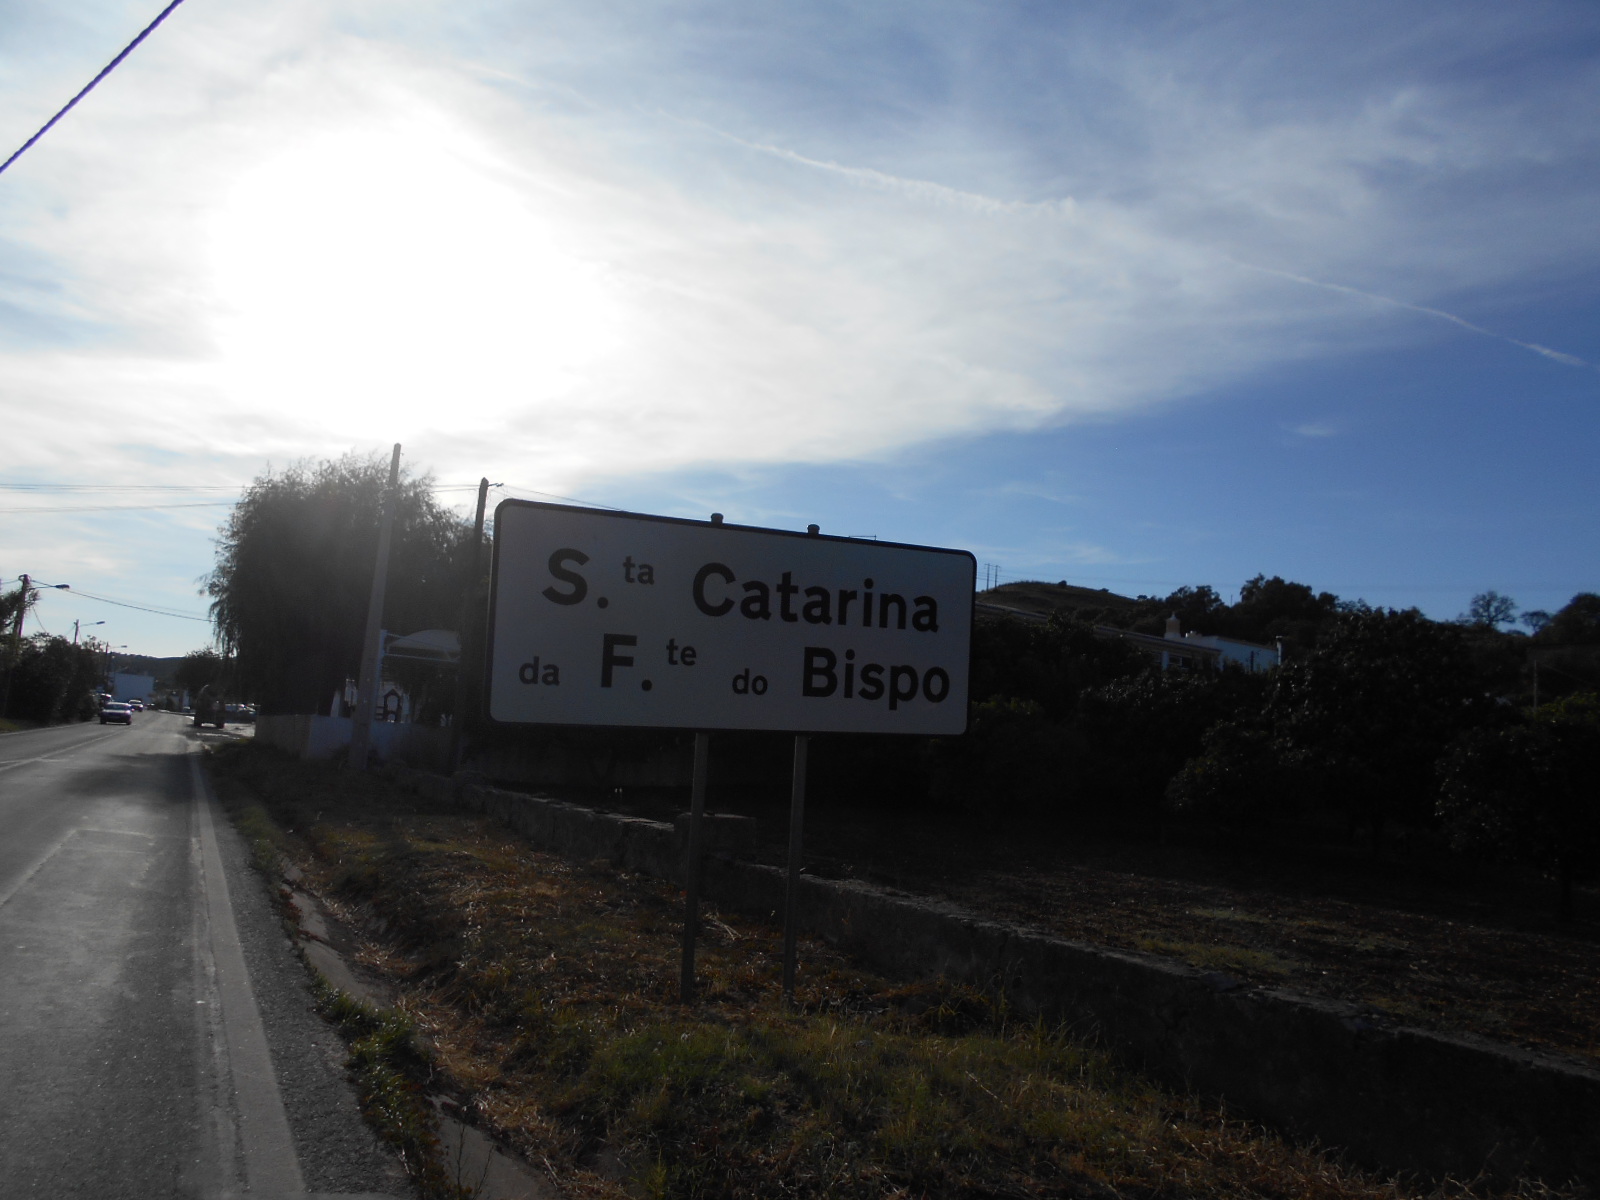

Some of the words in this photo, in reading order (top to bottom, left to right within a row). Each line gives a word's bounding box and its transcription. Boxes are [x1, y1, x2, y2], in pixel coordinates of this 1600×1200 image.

[692, 563, 939, 632] Catarina
[518, 656, 560, 686] da
[732, 668, 768, 696] do
[802, 646, 951, 711] Bispo
